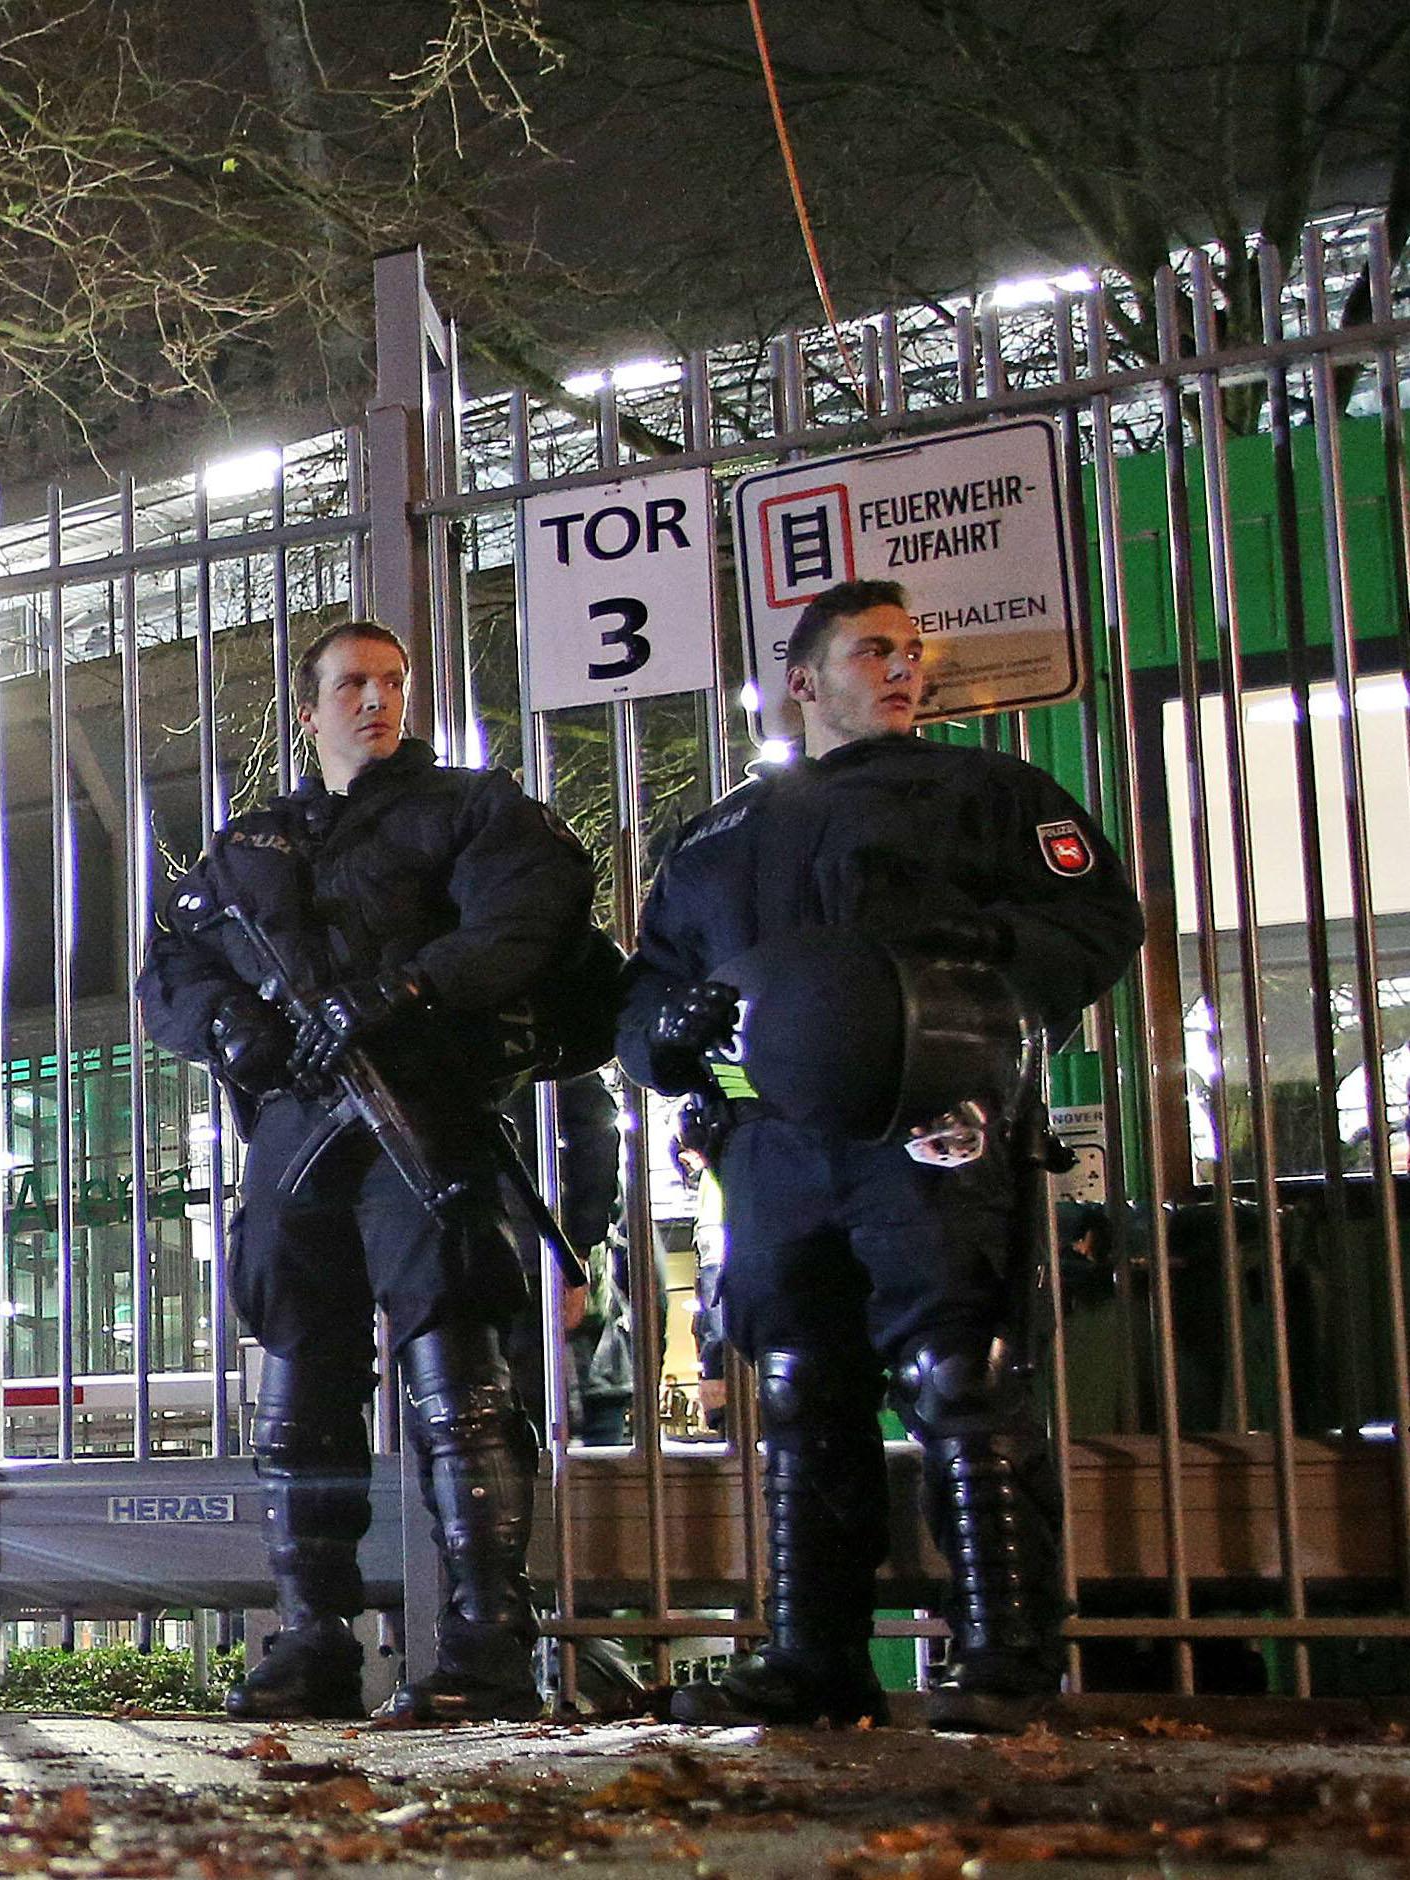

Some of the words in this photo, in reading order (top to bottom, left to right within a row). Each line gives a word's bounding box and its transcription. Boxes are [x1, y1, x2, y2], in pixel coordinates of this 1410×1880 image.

[540, 498, 691, 567] TOR
[859, 474, 1036, 533] FEUERWEHR-
[886, 519, 1002, 568] ZUFAHRT
[586, 597, 652, 680] 3
[112, 1497, 228, 1521] HERAS
